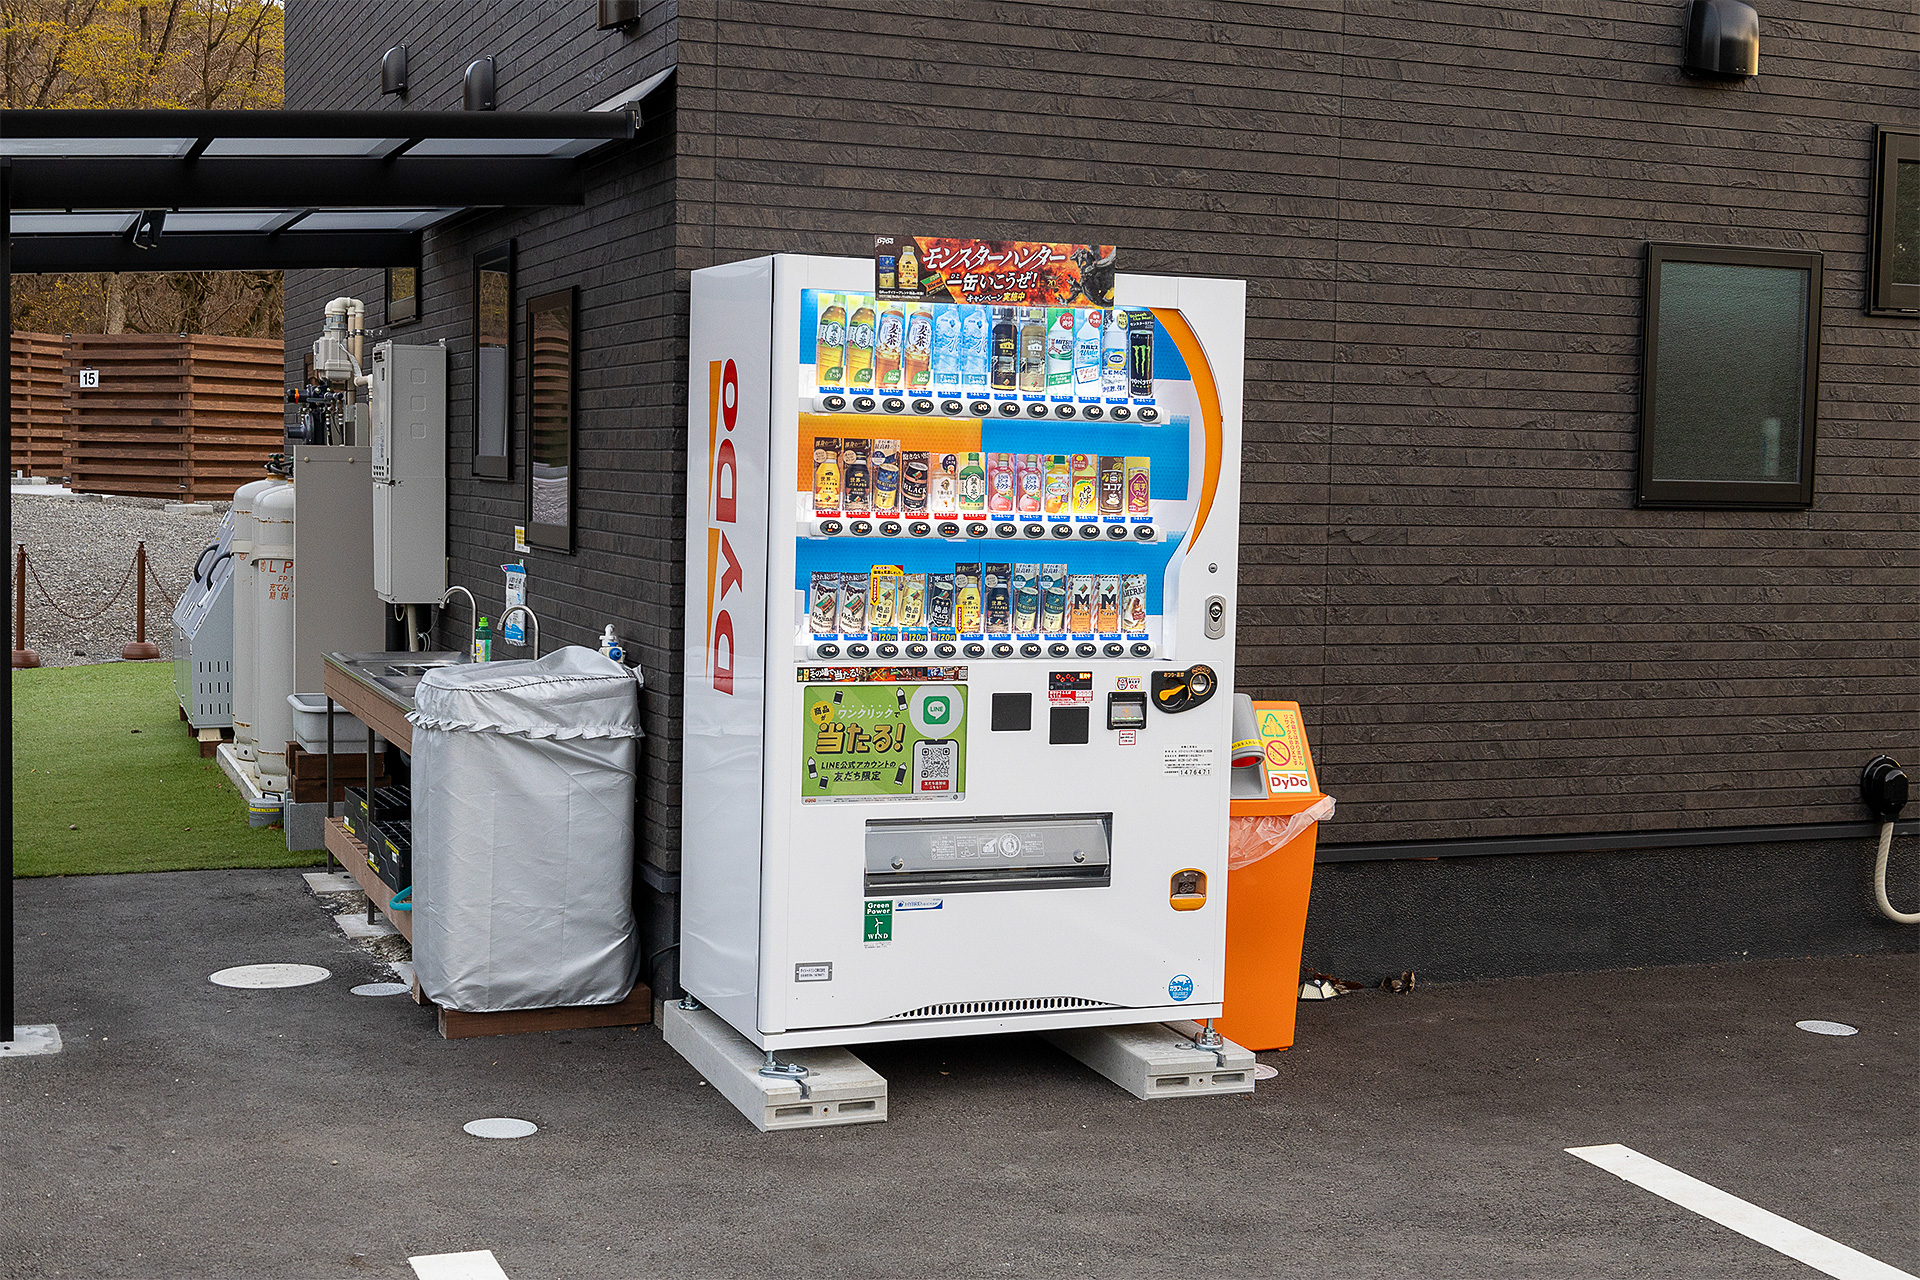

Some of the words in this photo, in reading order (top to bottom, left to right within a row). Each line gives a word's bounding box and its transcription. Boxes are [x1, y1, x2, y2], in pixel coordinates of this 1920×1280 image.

[922, 245, 1066, 271] モンスターハンター
[946, 271, 1039, 292] 一缶いこうぜ!
[966, 292, 1026, 303] キャンペーン実施中
[83, 372, 95, 386] 15
[1074, 594, 1090, 609] M
[1101, 594, 1117, 609] M
[815, 722, 906, 754] 当たる!
[821, 761, 897, 770] LINE公式アカウントの
[834, 771, 881, 782] 友だち限定
[1271, 777, 1308, 789] DyDo
[867, 932, 889, 940] WIND
